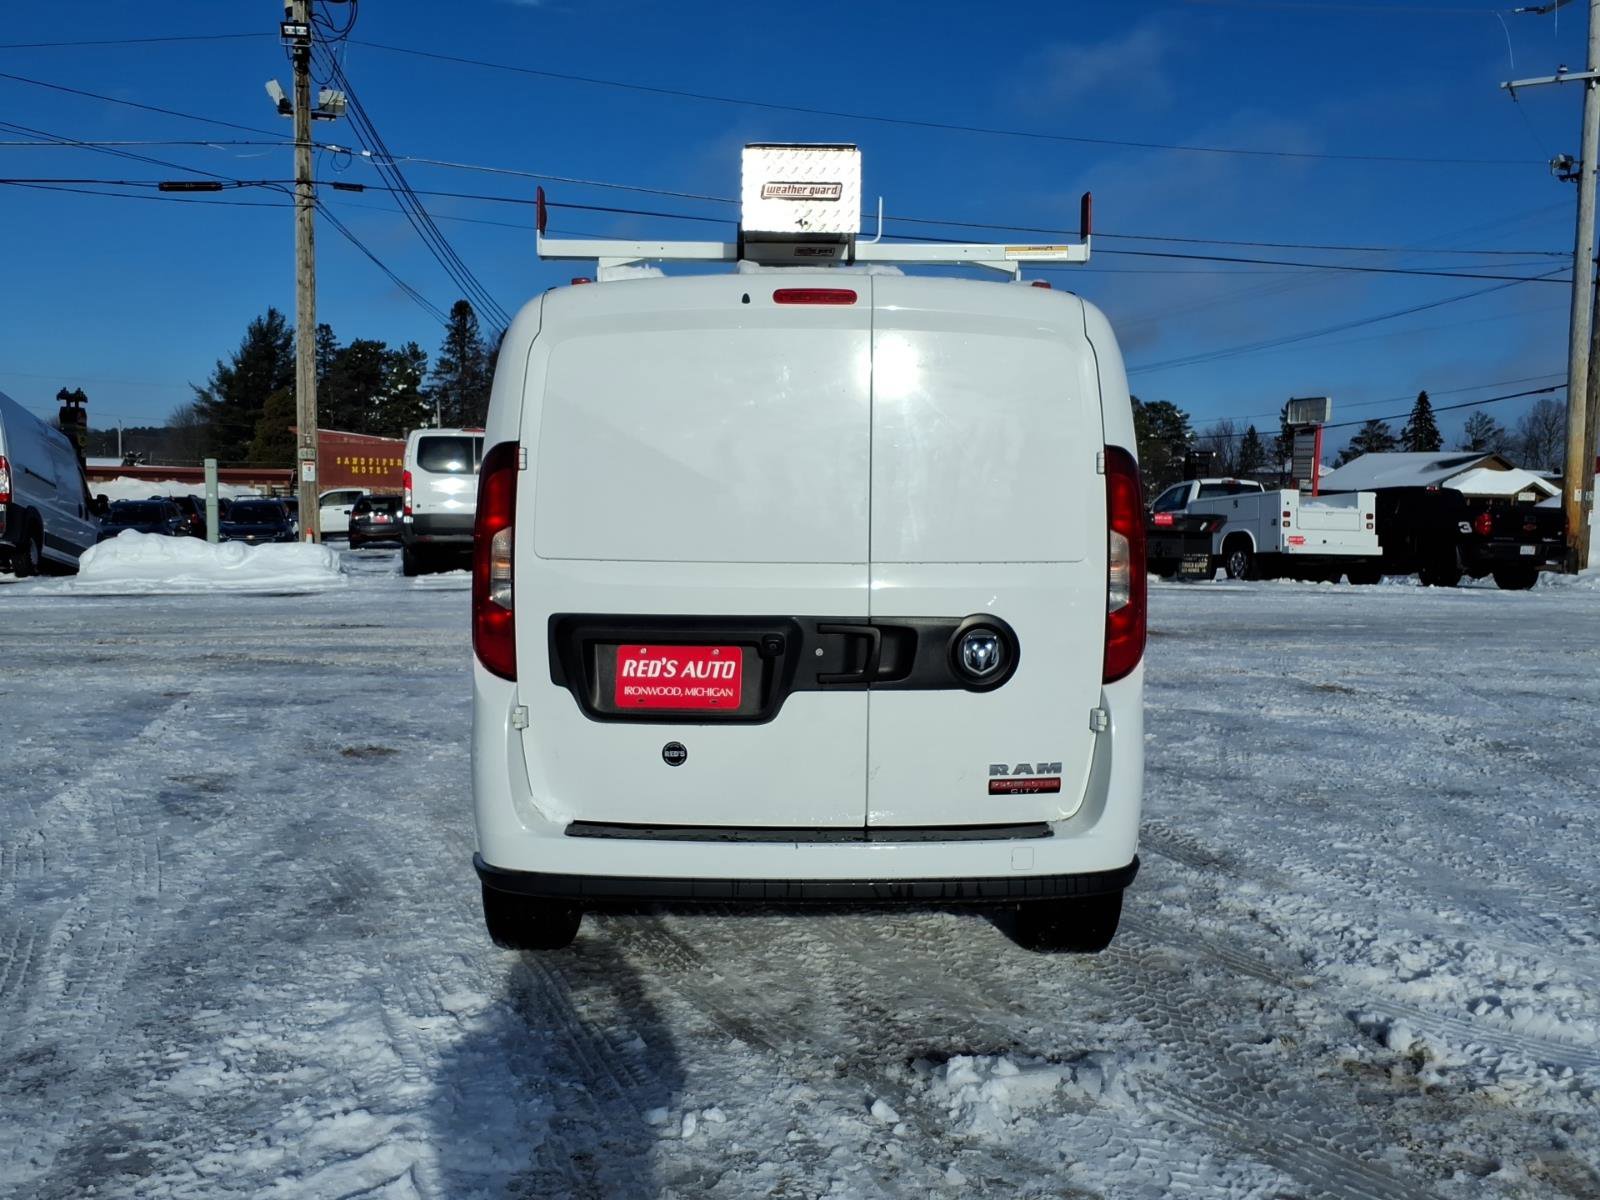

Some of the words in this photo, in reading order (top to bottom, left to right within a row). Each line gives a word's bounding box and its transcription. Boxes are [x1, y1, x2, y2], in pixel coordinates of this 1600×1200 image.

[766, 184, 807, 194] weather
[809, 185, 838, 196] guard
[352, 466, 389, 474] MOTEL
[1458, 521, 1473, 533] 3
[622, 657, 679, 678] RED'S
[681, 660, 736, 679] AUTO
[624, 686, 684, 697] IRONWOOD,
[685, 687, 734, 697] MICHIGAN
[989, 762, 1062, 776] RAM
